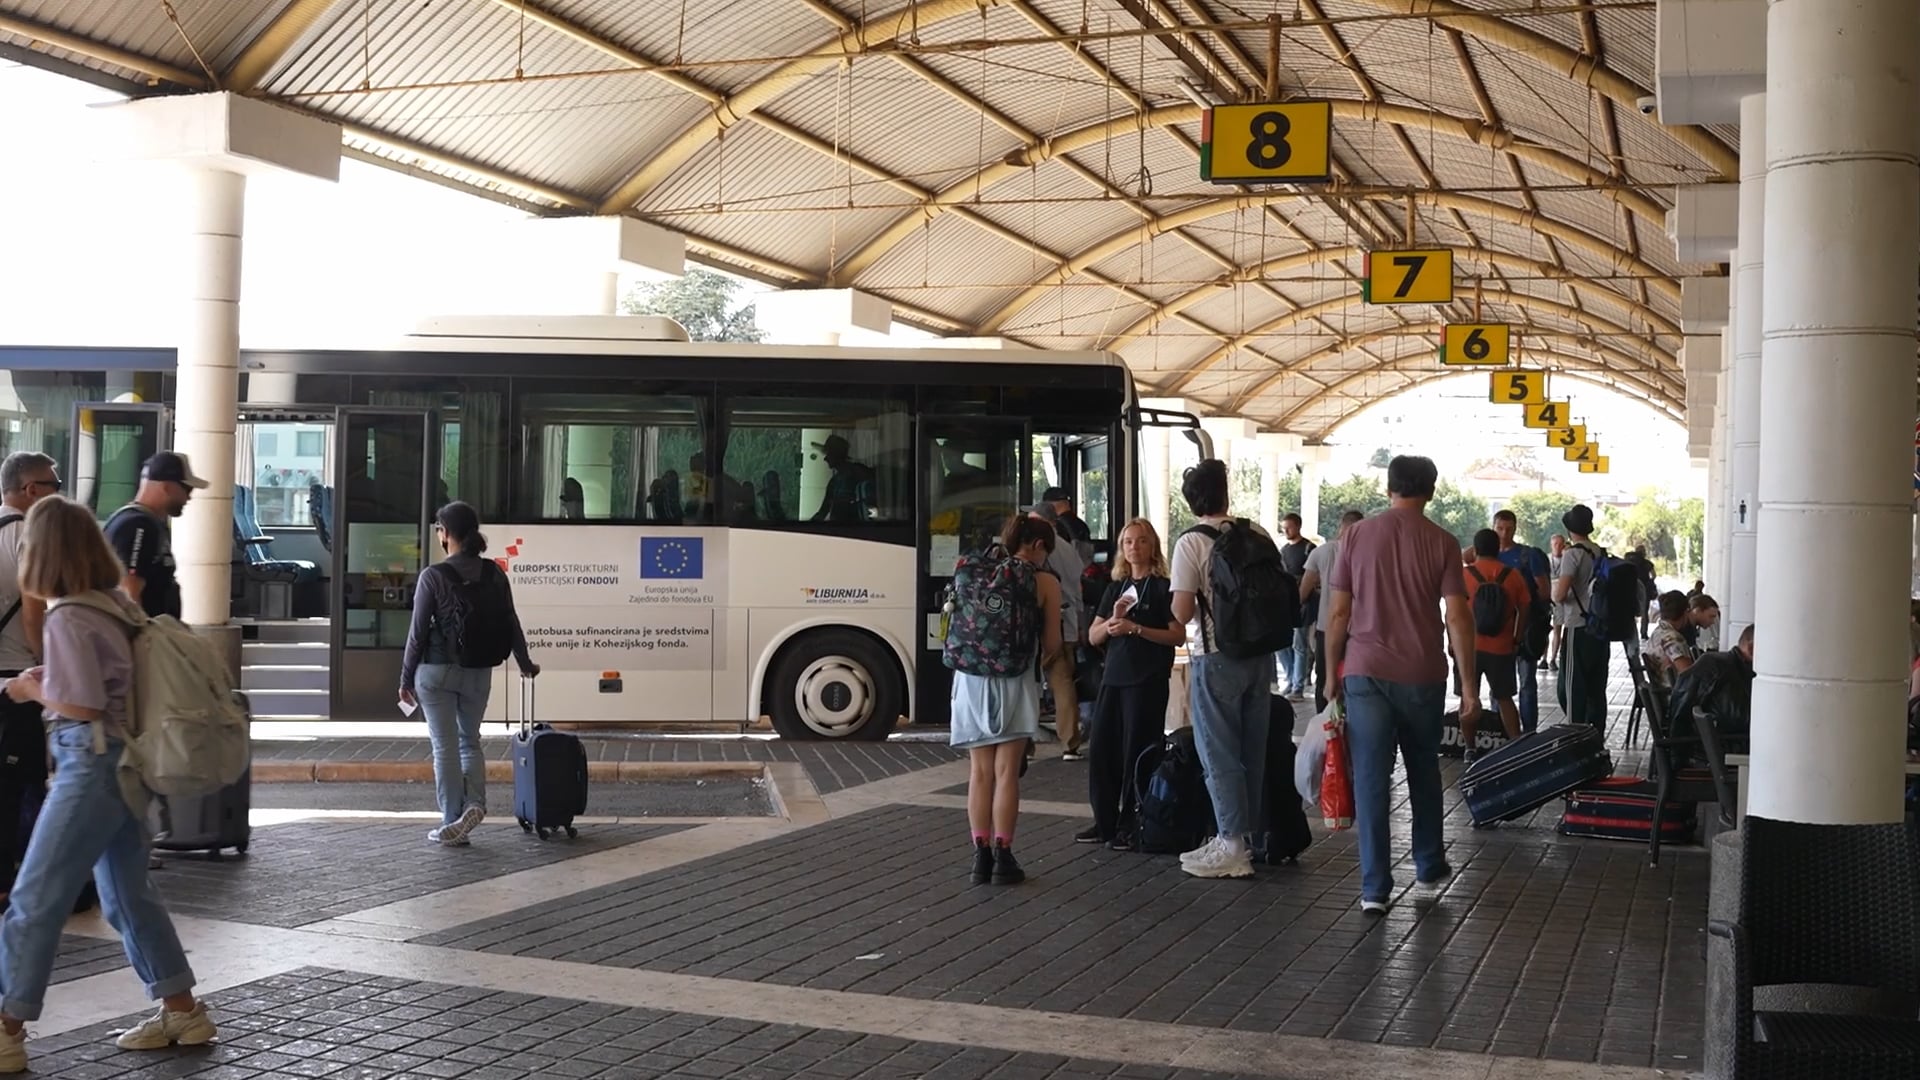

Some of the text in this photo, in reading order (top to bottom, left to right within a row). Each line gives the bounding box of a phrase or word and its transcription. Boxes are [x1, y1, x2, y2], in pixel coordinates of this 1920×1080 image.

[1246, 111, 1291, 169] 8
[1393, 256, 1427, 298] 7
[1463, 329, 1490, 360] 6
[1508, 374, 1529, 401] 5
[1538, 404, 1558, 426] 4
[1560, 428, 1576, 446] 3
[1576, 446, 1590, 461] 2
[513, 564, 619, 573] EUROPSKI STRUKTURNI
[518, 576, 575, 587] INVESTICIJSKI
[577, 576, 618, 585] FONDOVI
[644, 585, 698, 595] Europska unija
[814, 588, 868, 598] LIBURNIJA
[629, 595, 714, 603] Zajedno do fondova EU
[527, 626, 709, 638] autobusa sufinancirana je sredstvima
[556, 639, 580, 650] unije
[582, 639, 591, 648] iz
[594, 639, 654, 650] Kohezijskog
[657, 639, 689, 649] fonda.
